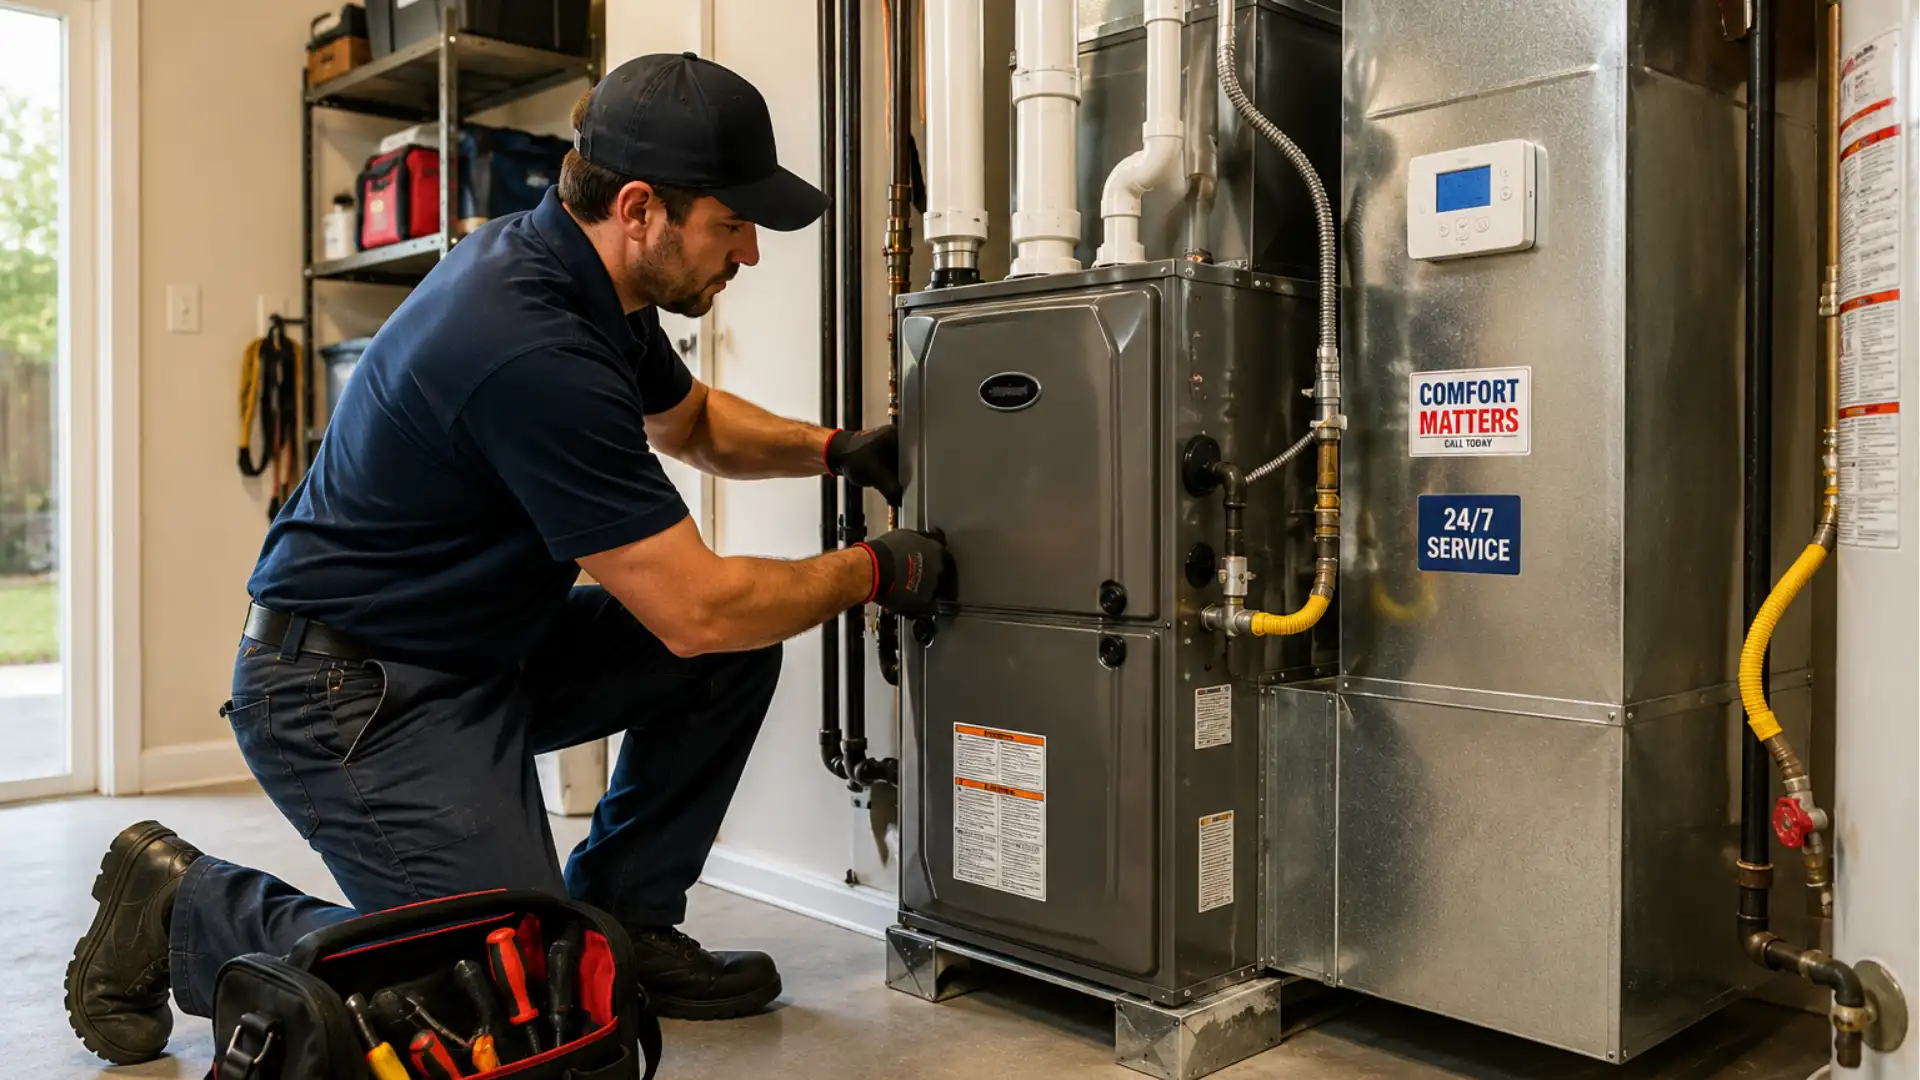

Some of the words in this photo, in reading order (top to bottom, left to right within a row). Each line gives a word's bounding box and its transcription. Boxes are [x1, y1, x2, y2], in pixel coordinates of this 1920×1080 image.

[1419, 378, 1519, 406] COMFORT
[1420, 408, 1519, 435] MATTERS
[1444, 438, 1463, 449] CALL
[1466, 438, 1493, 448] TODAY
[1444, 507, 1494, 533] 24/7
[1427, 536, 1510, 562] SERVICE
